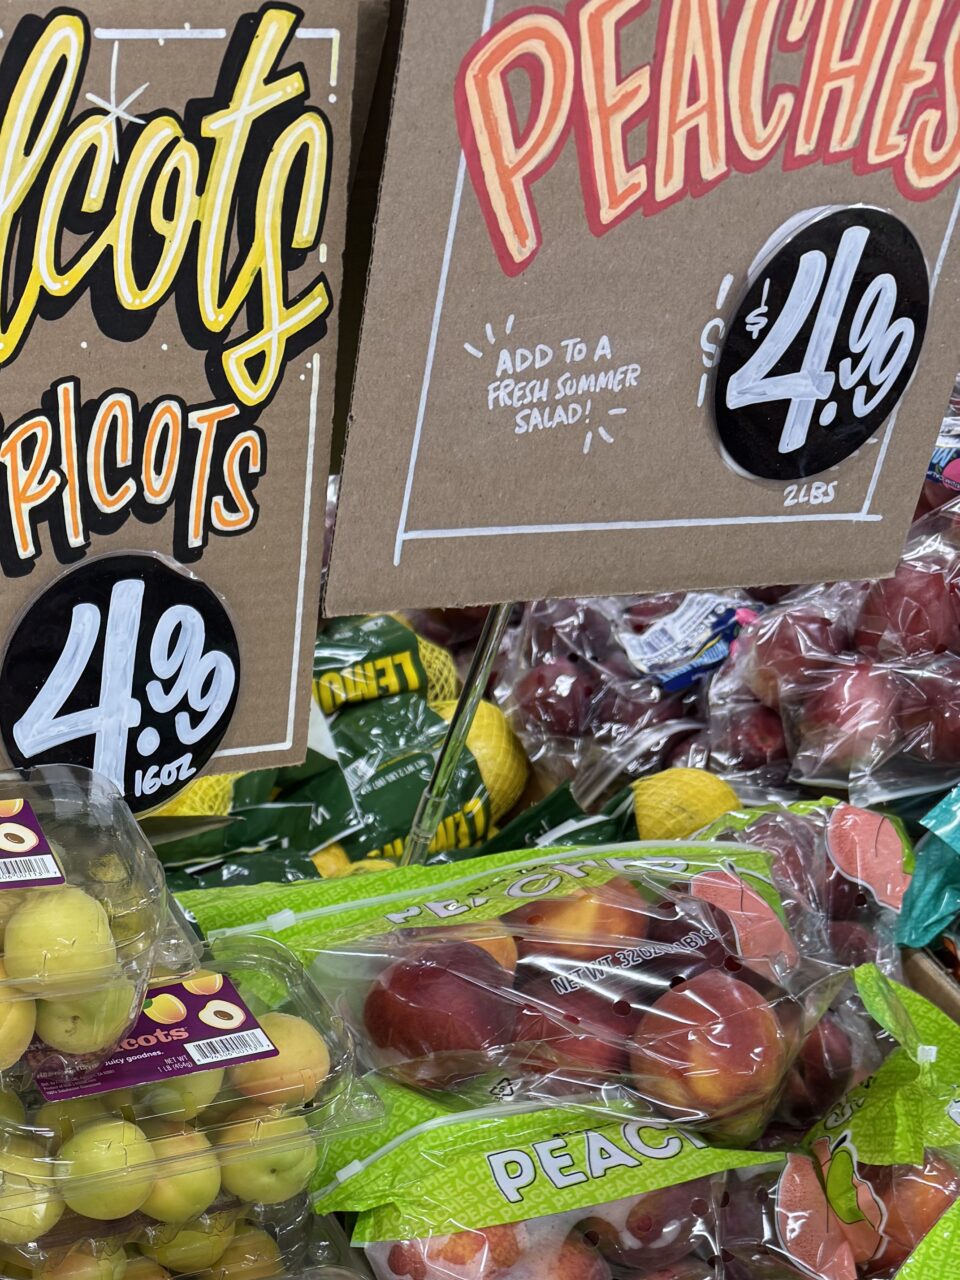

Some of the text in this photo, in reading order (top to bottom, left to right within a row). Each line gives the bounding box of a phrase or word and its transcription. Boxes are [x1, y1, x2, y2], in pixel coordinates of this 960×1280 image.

[496, 334, 612, 378] ADD TO A
[487, 363, 641, 410] FRESH SUMMER
[514, 399, 591, 434] SALAD!
[13, 579, 236, 798] 4.99
[312, 650, 421, 716] LEMO
[127, 1050, 164, 1061] goodnes.
[486, 1120, 700, 1203] PEAC
